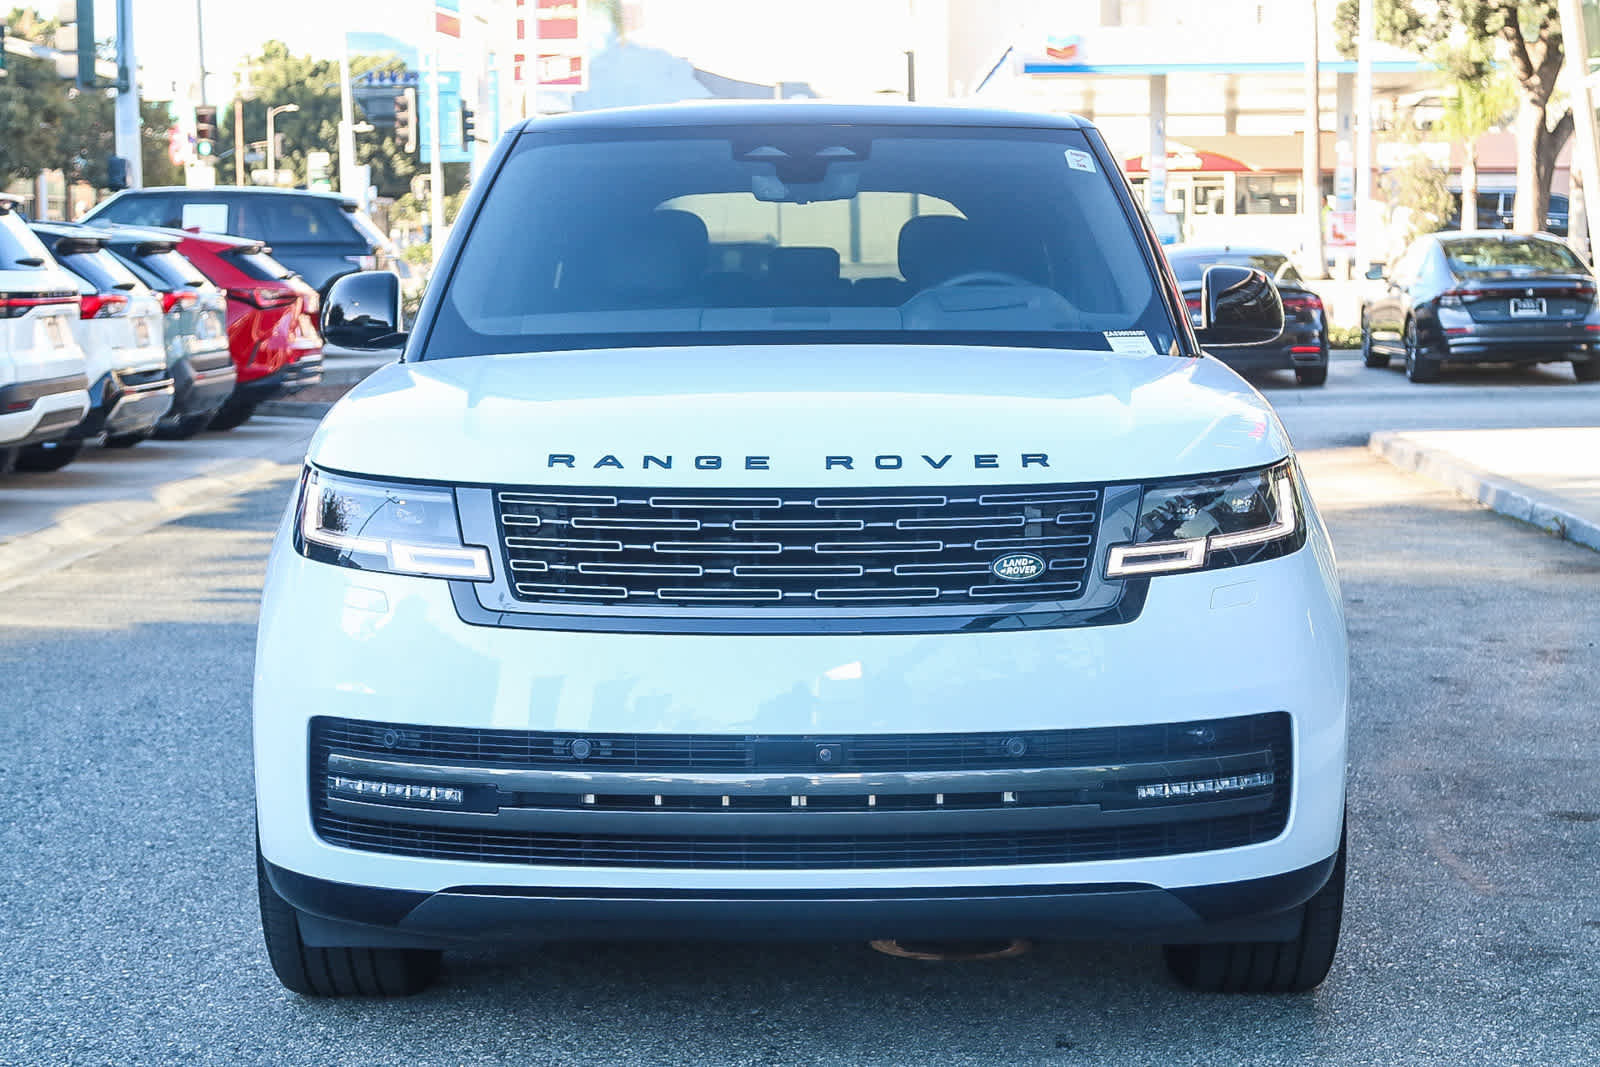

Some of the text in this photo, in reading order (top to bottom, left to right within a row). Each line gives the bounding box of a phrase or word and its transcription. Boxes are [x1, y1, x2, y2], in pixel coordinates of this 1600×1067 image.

[548, 454, 1049, 470] RANGE ROVER
[1003, 558, 1028, 567] LAND
[1006, 565, 1037, 575] ROVER
